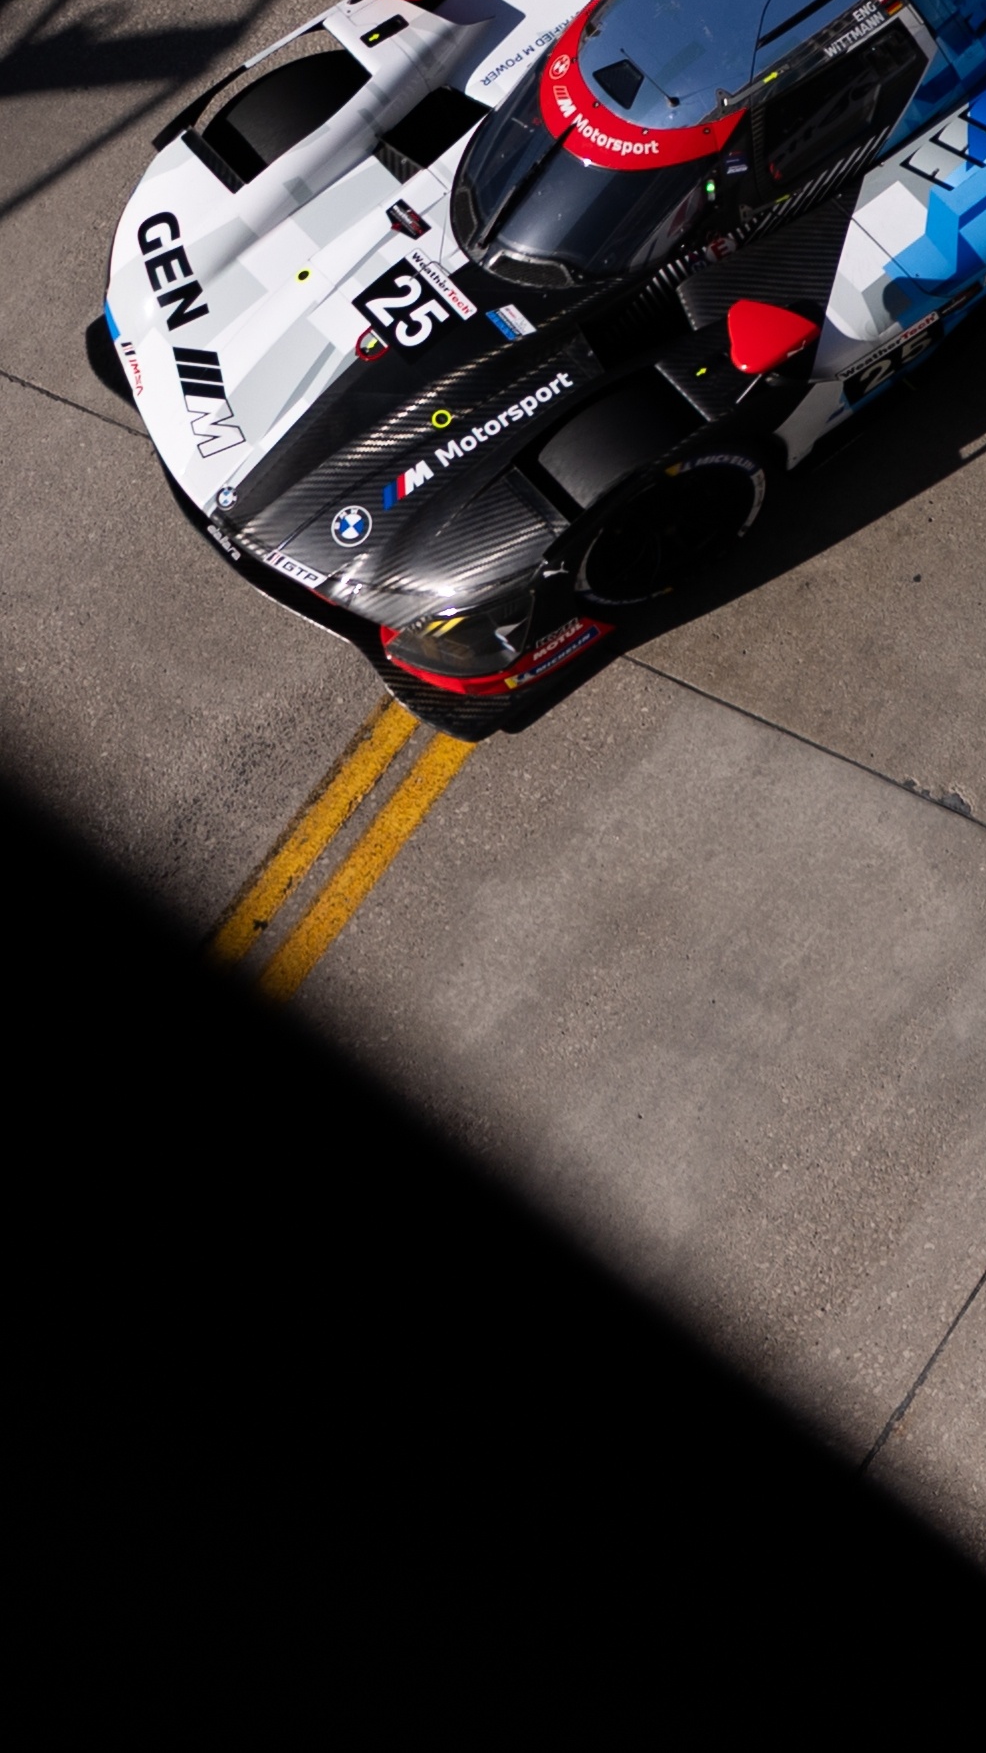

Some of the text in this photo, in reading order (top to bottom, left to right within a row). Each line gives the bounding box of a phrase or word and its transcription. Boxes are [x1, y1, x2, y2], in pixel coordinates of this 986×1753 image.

[852, 1, 877, 22] ENG
[522, 45, 536, 56] M
[824, 11, 885, 58] WITTMANN
[481, 53, 523, 86] POWER
[571, 113, 659, 156] Motorsport
[137, 211, 209, 331] GEN
[412, 252, 472, 315] WeatherTech
[365, 275, 450, 347] 25
[841, 313, 937, 379] WeatherTech
[434, 372, 573, 467] Motorsport
[694, 454, 756, 471] MICHELIN
[282, 561, 319, 582] GTP
[533, 623, 584, 661] MOTUL
[536, 633, 591, 674] MICHELIN
